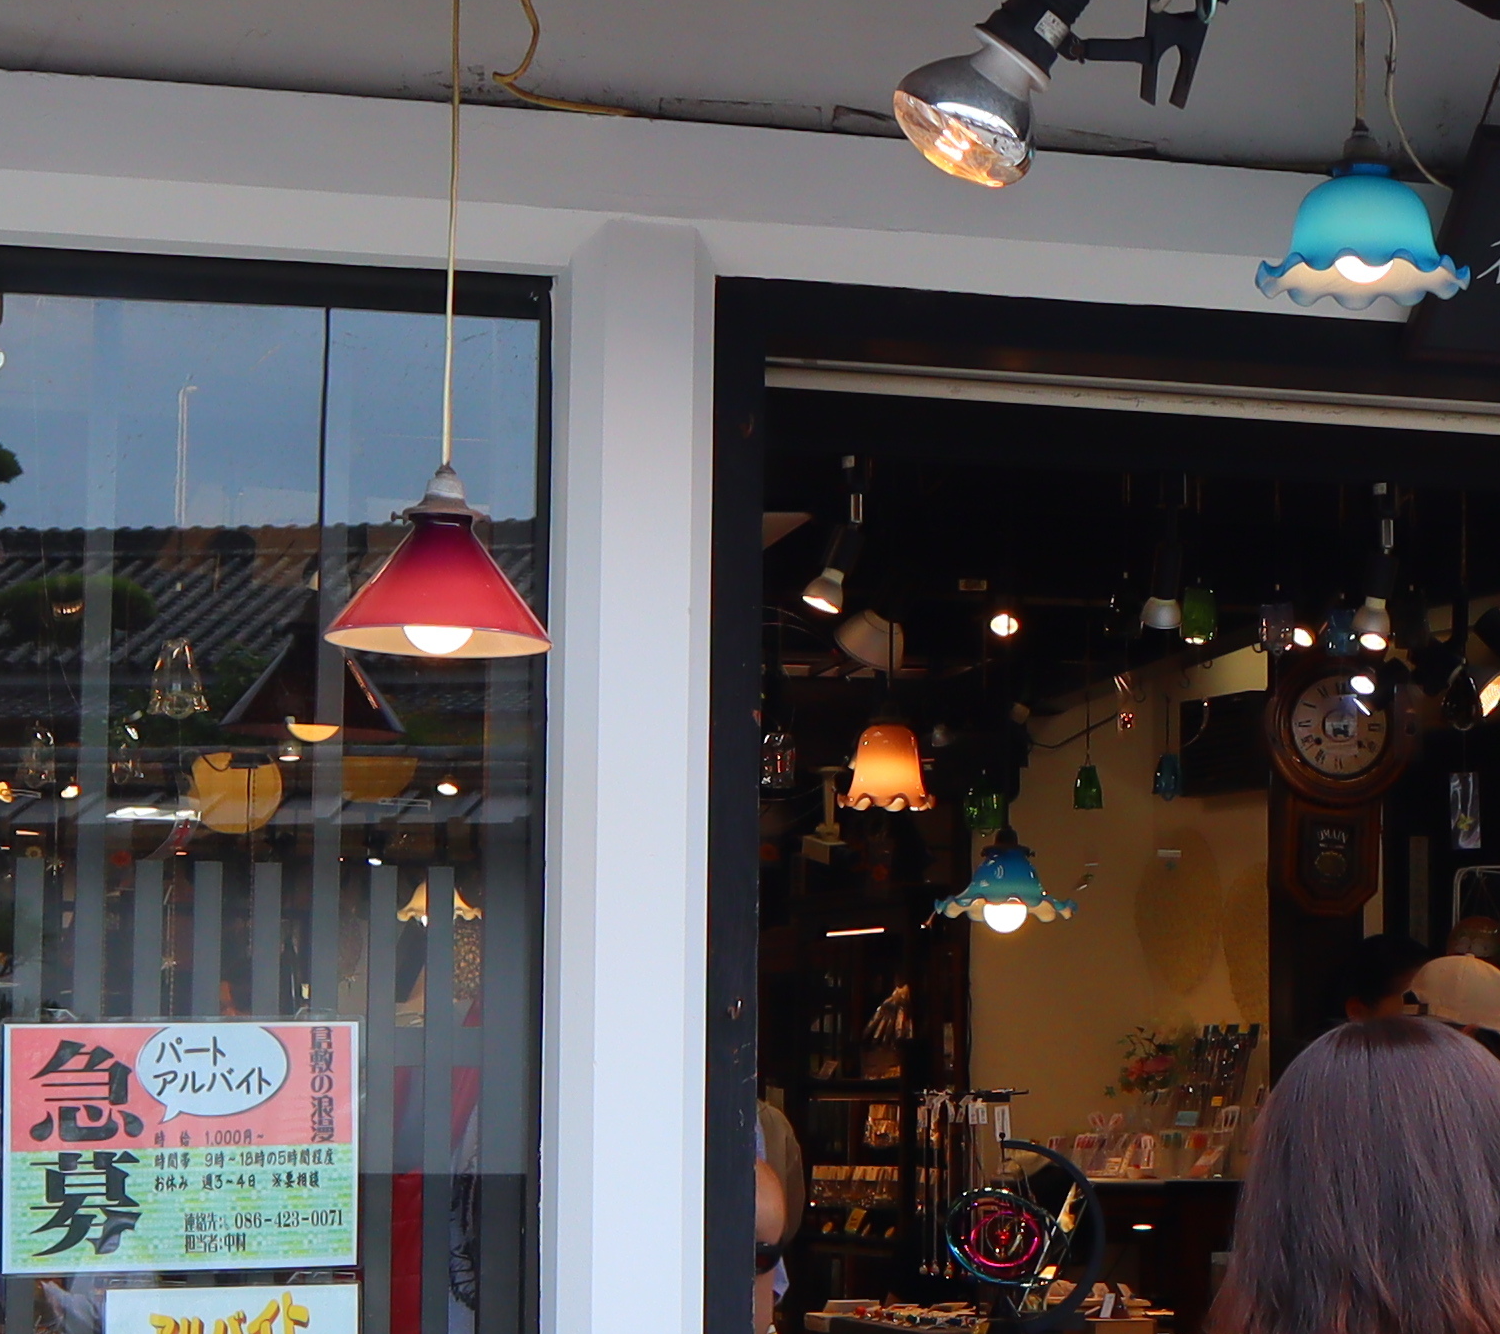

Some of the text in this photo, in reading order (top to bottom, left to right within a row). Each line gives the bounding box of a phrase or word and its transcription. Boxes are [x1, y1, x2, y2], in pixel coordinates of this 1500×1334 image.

[156, 1036, 226, 1066] パート
[153, 1066, 272, 1097] アルバイト
[308, 1026, 335, 1143] 倉敷の浪漫
[29, 1039, 145, 1257] 急募
[154, 1175, 188, 1191] お休み
[234, 1210, 344, 1230] 086-423-0071
